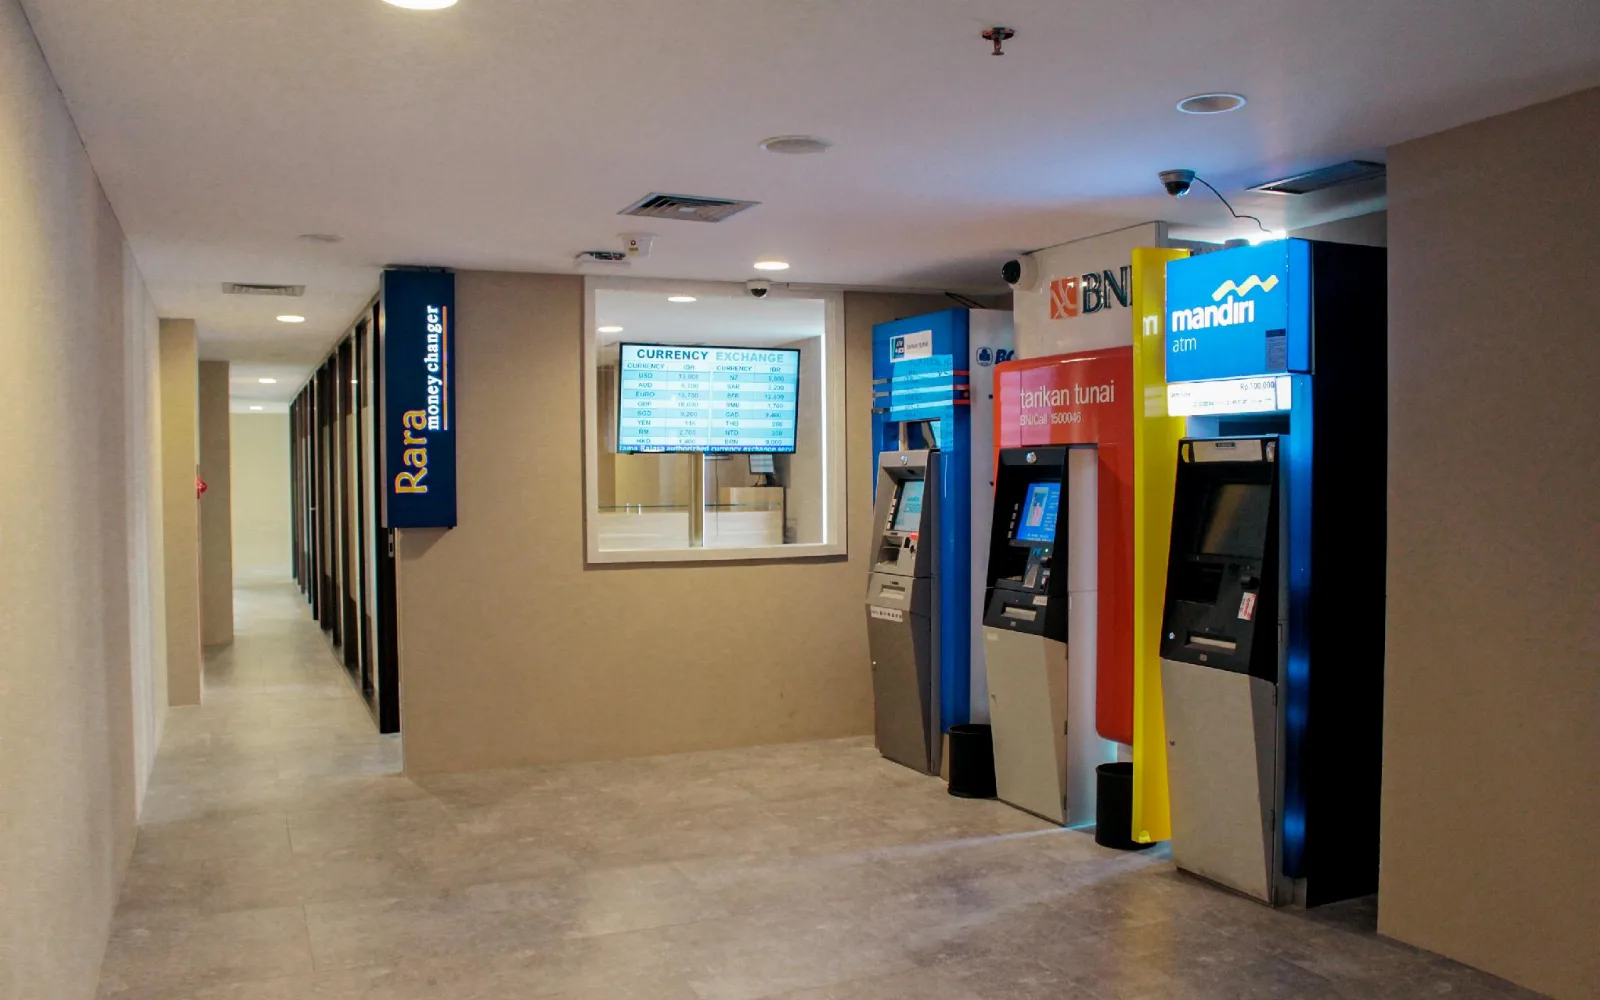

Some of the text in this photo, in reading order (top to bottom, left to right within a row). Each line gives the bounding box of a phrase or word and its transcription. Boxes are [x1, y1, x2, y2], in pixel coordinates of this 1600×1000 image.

[1172, 295, 1254, 332] mandiri
[637, 349, 784, 363] CURRENCY EXCHANGE
[1172, 337, 1197, 353] atm
[424, 305, 442, 430] money changer
[1020, 380, 1114, 409] tarikan tunai
[394, 408, 428, 494] Rara
